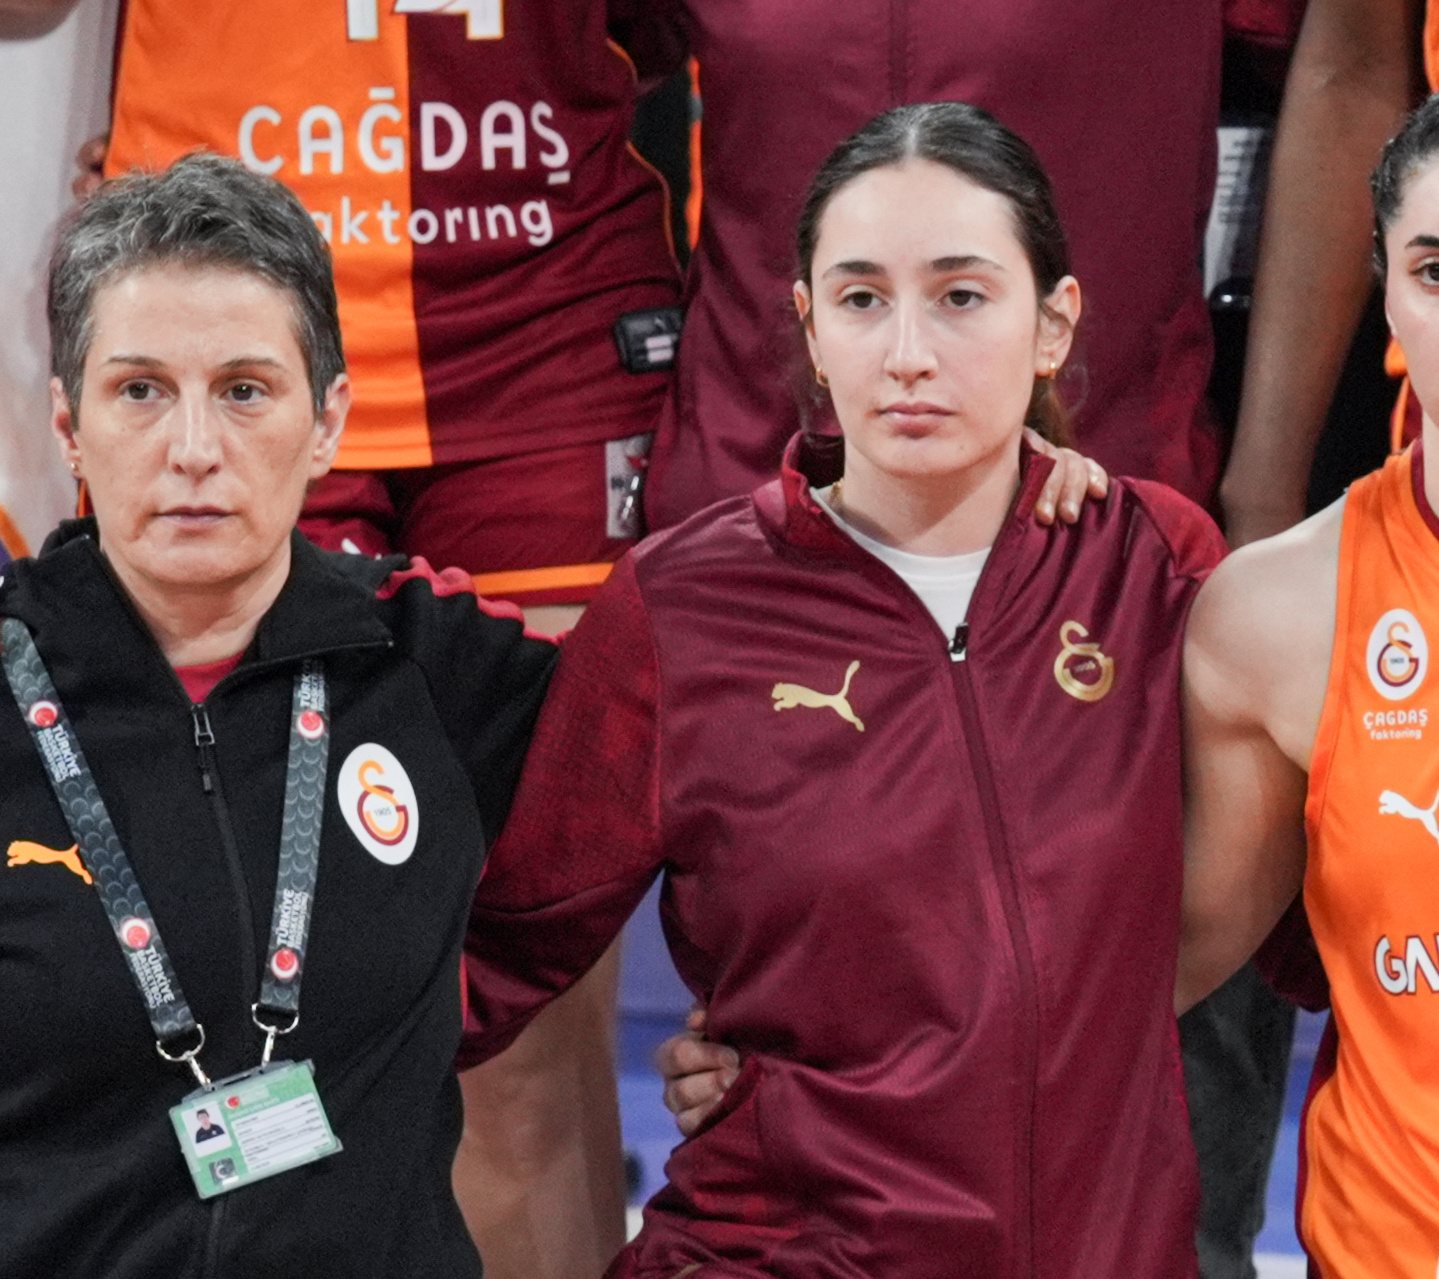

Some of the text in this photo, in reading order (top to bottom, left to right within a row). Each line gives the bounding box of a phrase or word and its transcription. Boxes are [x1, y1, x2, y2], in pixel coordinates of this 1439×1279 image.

[312, 195, 554, 248] aktoring
[1370, 727, 1422, 740] faktoring
[373, 806, 392, 818] 1905
[146, 946, 175, 1003] TÜRKİYE
